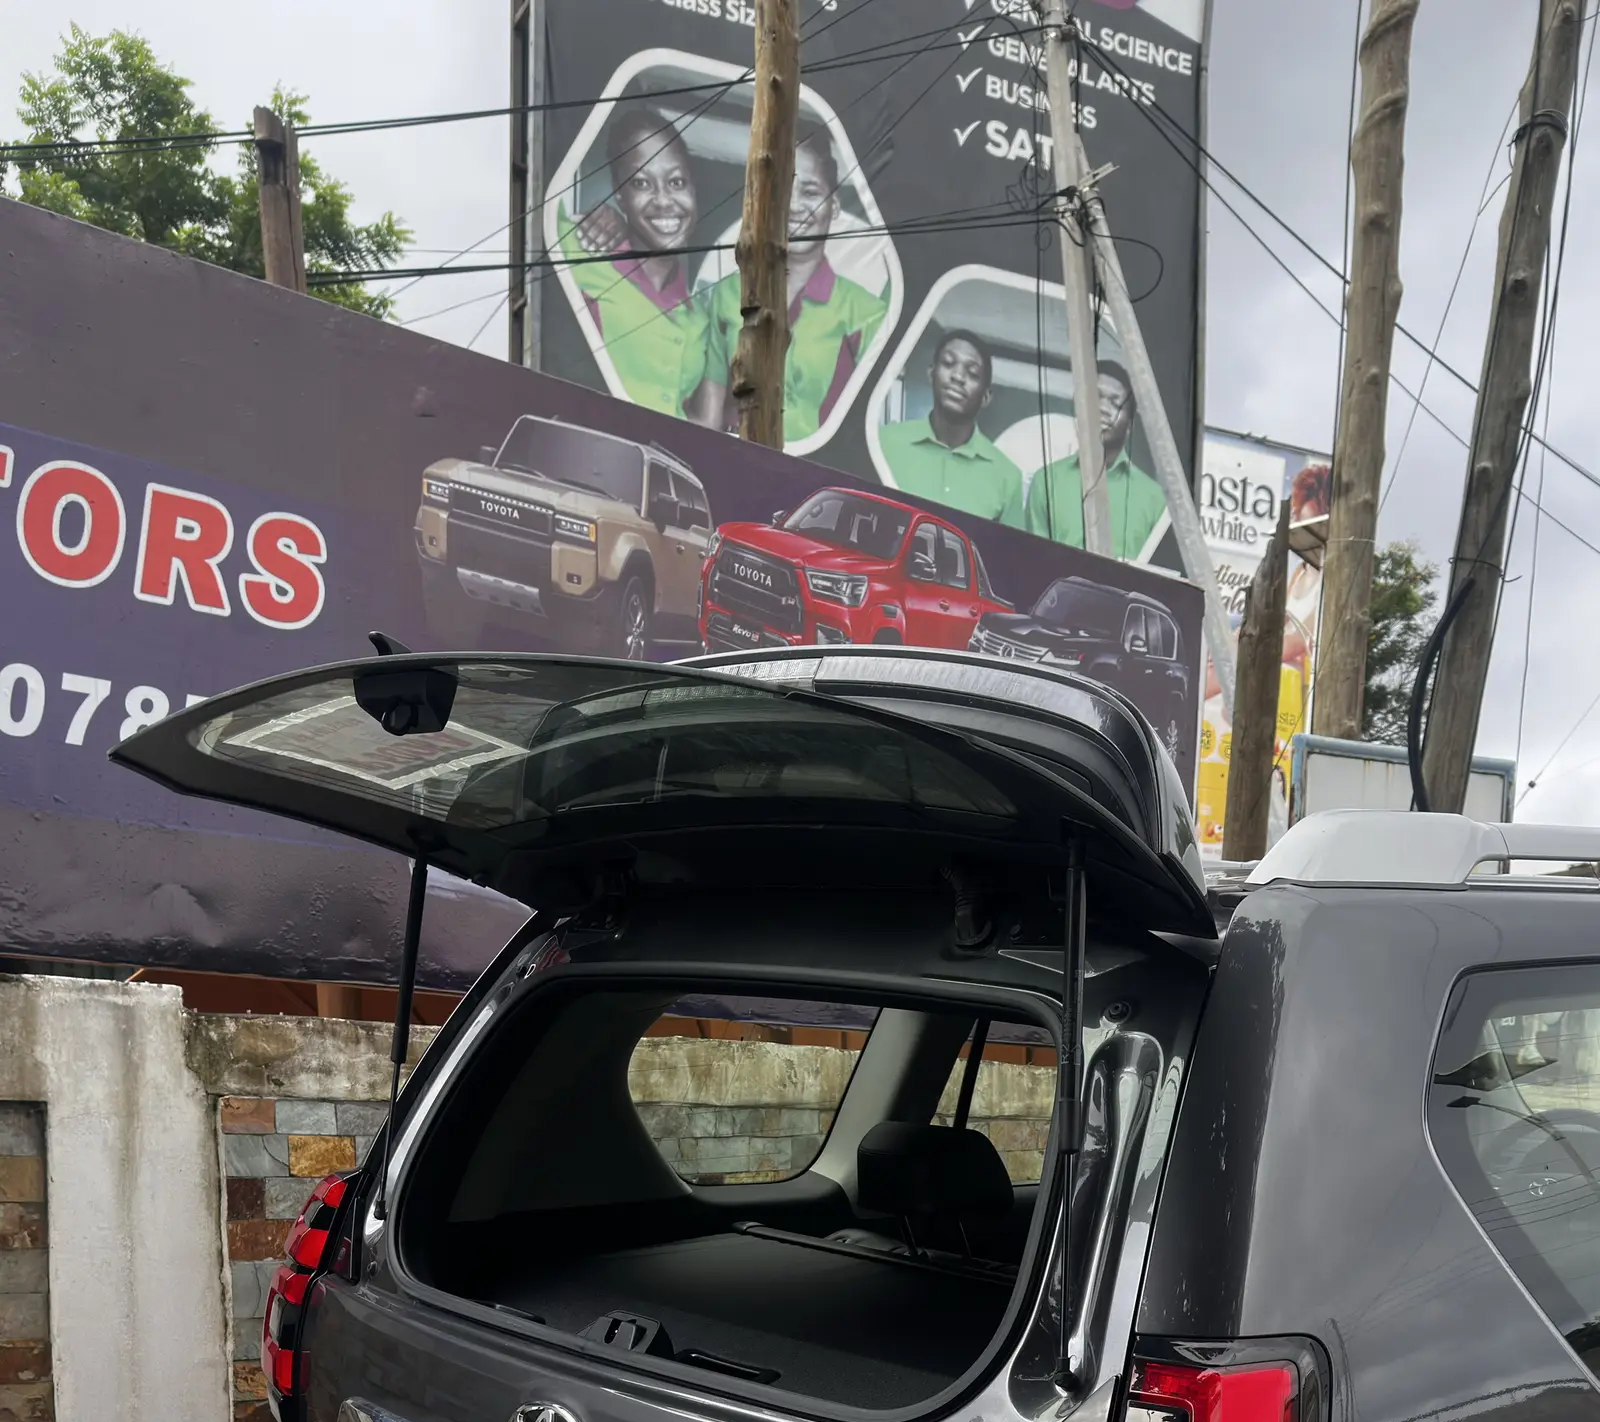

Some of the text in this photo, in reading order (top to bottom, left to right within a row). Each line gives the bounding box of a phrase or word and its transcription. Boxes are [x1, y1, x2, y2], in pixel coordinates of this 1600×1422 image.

[661, 0, 756, 27] ass Siz
[987, 33, 1095, 87] GENEAL
[1100, 27, 1193, 76] SCIENCE
[985, 74, 1098, 129] BUSINSS
[480, 500, 520, 520] TOYOTA
[1201, 511, 1258, 545] white
[0, 446, 328, 630] ORS
[733, 562, 772, 587] TOYOTA
[0, 662, 211, 747] 078
